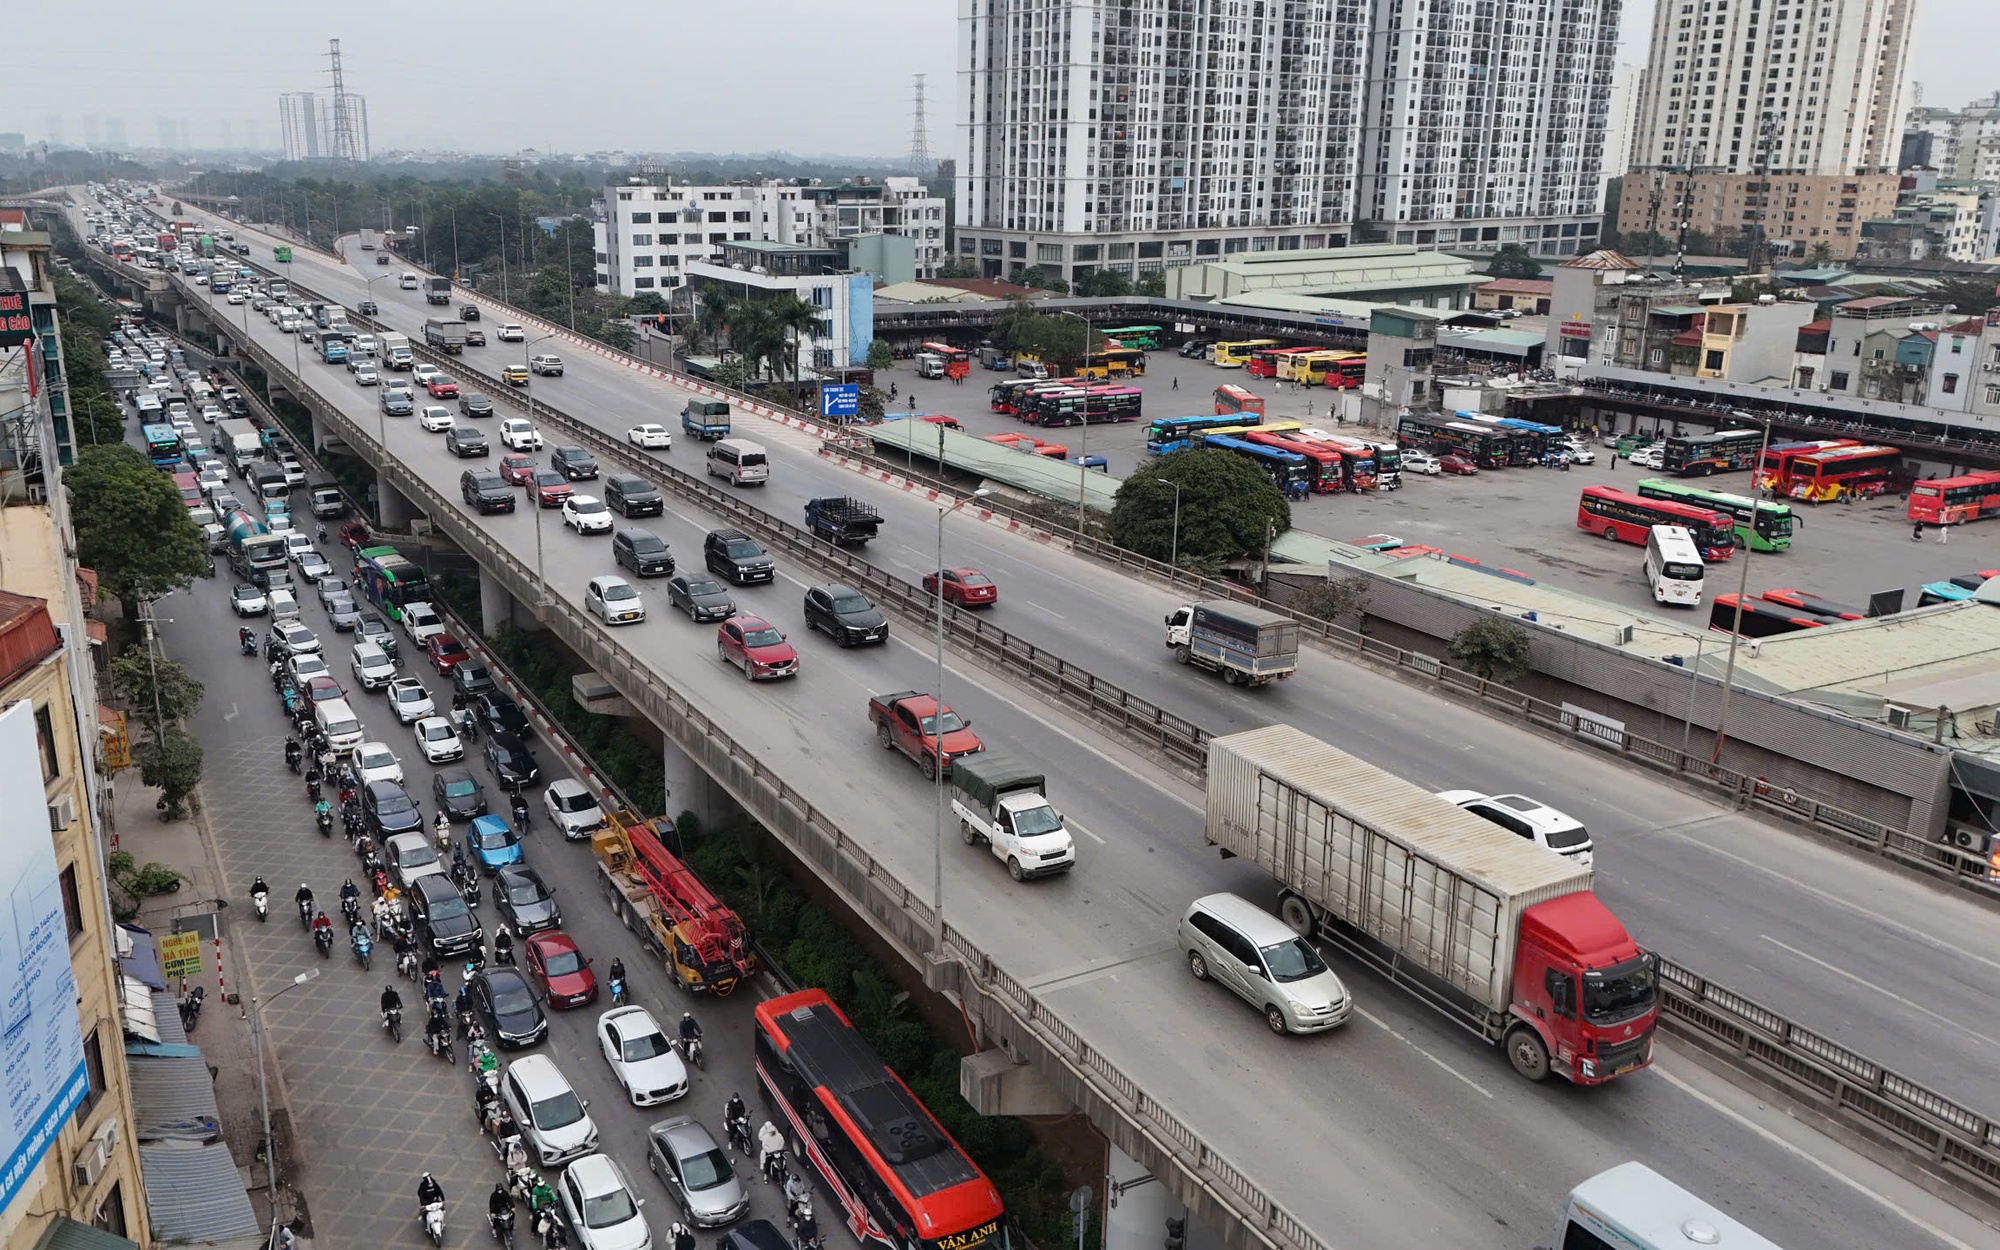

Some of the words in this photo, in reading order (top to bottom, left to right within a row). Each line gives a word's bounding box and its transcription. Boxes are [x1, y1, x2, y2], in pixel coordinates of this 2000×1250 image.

[0, 293, 23, 310] HUÊ
[8, 313, 31, 330] CÁO
[28, 927, 40, 941] ISO
[184, 934, 196, 944] AN
[18, 951, 36, 972] CLEAN
[164, 959, 185, 970] CƠM
[166, 967, 185, 978] PHỞ
[8, 969, 41, 1008] GMP-WHO
[5, 1042, 31, 1077] HS-GMP
[937, 1235, 966, 1250] VÂN
[970, 1222, 998, 1241] ANH
